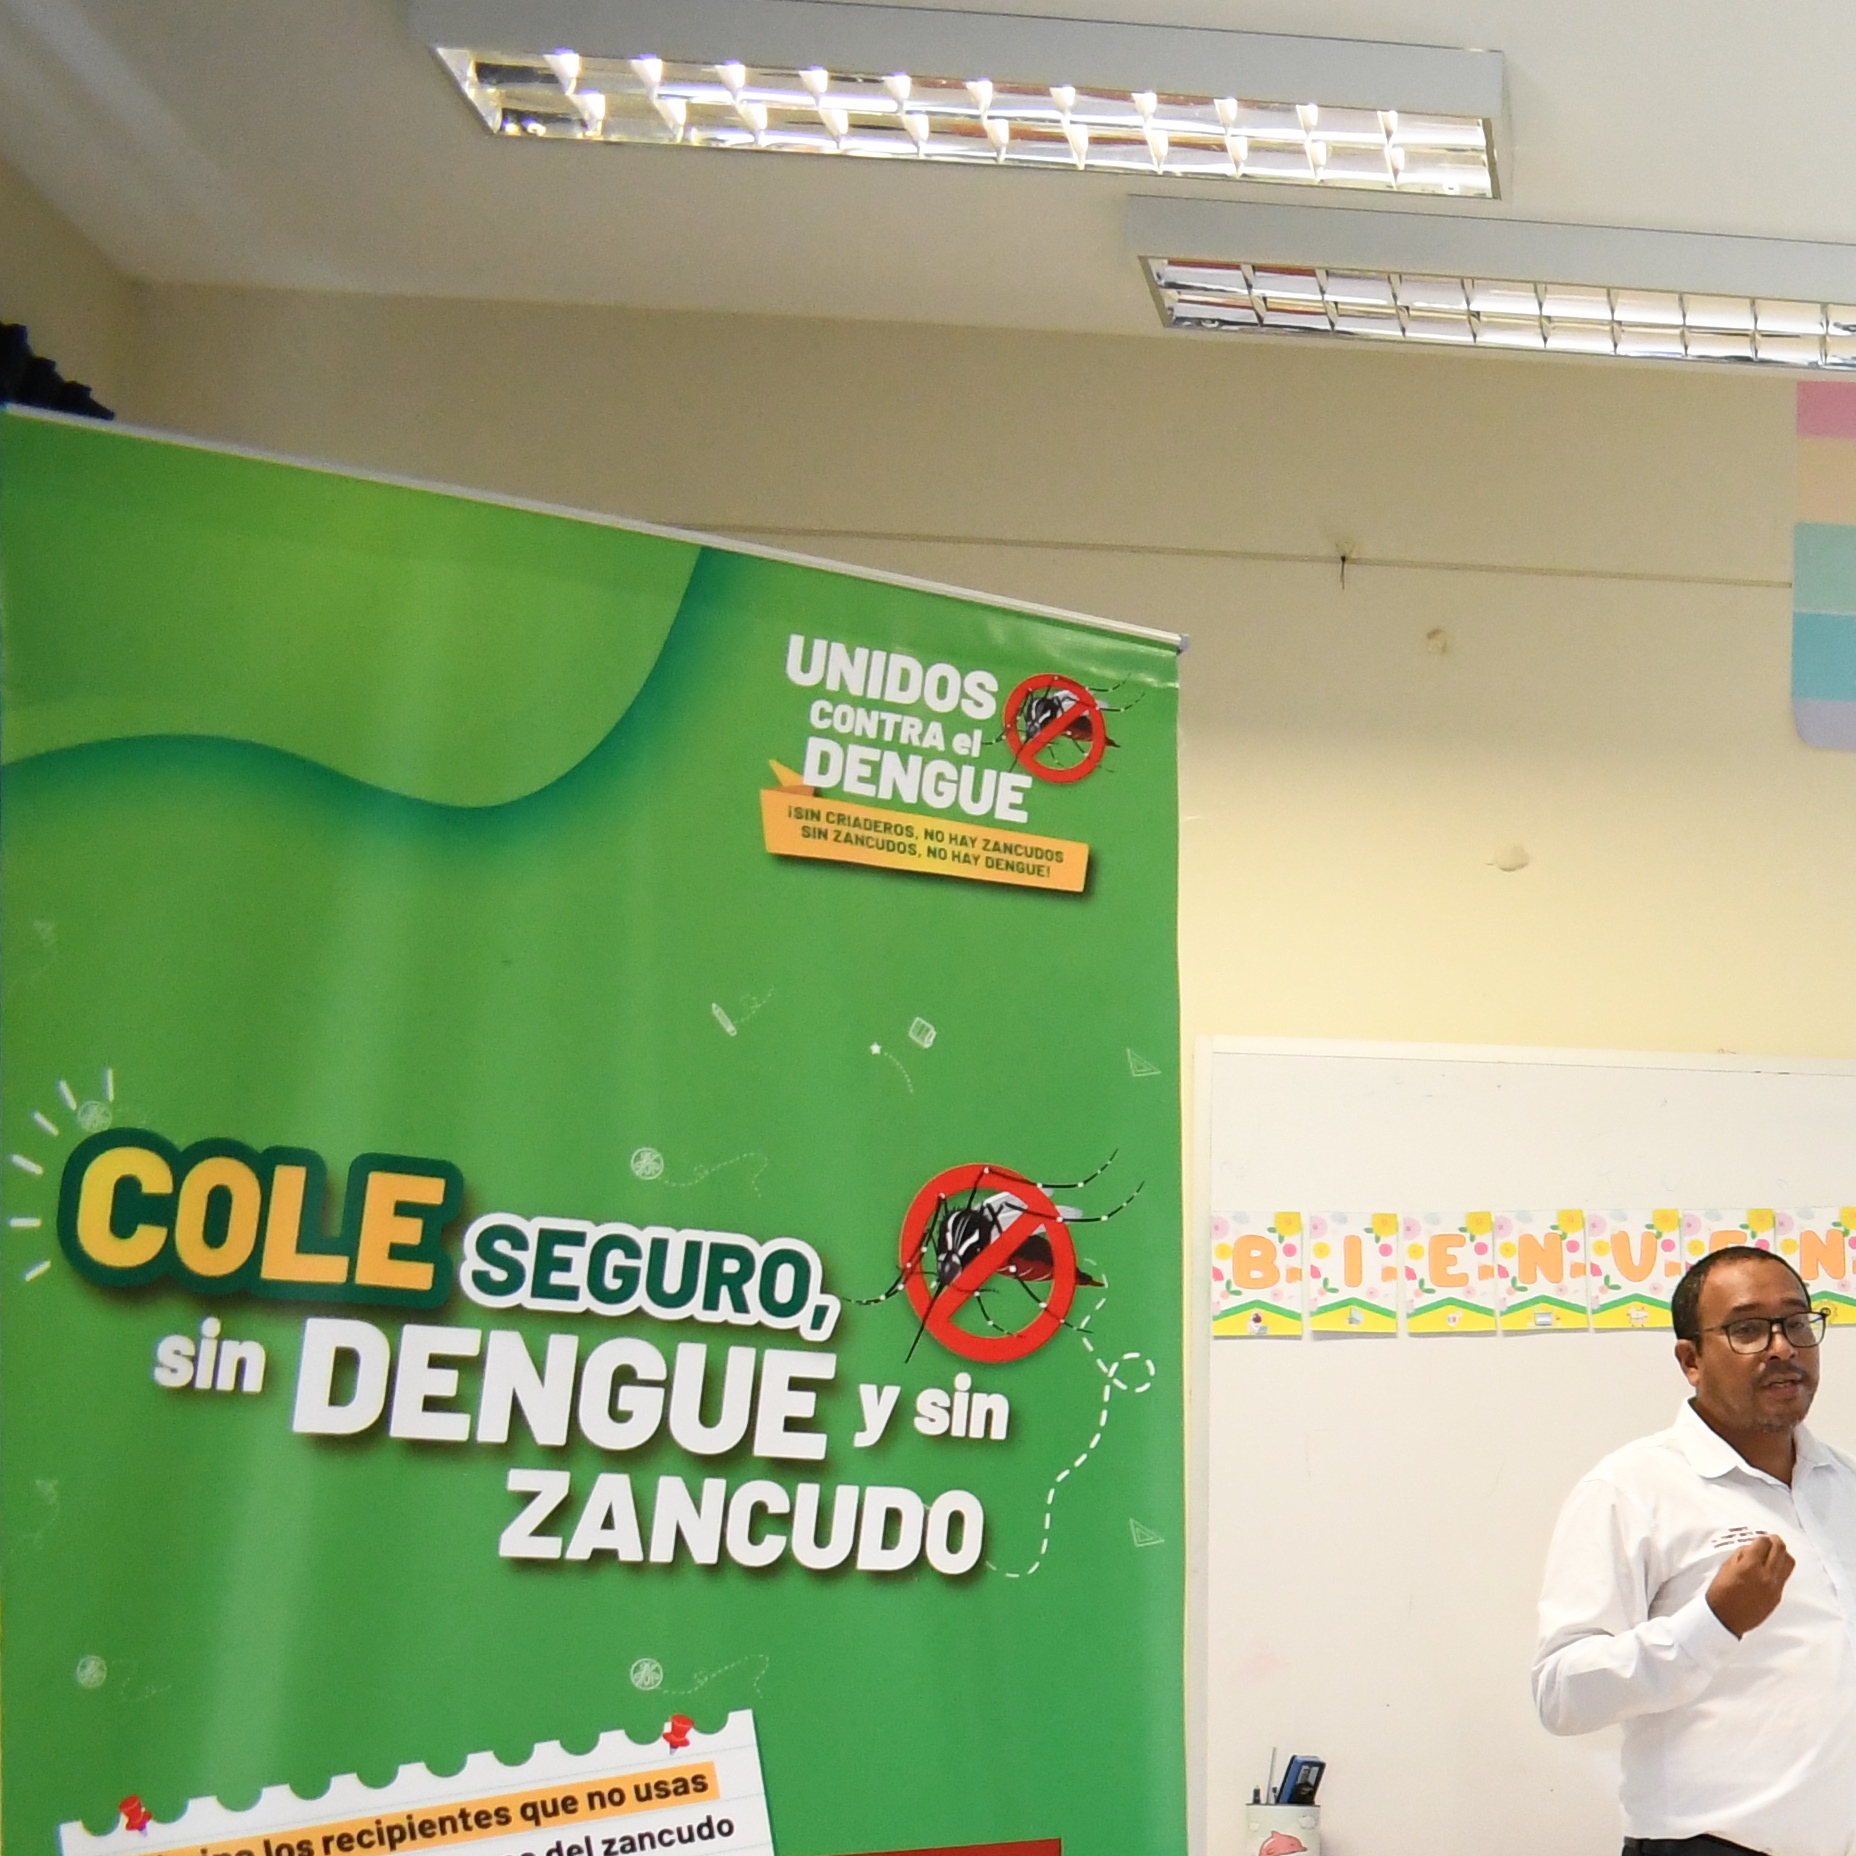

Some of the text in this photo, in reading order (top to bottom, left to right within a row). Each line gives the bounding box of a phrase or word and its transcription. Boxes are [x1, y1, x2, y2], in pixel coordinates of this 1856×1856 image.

[785, 633, 999, 720] UNIDOS
[810, 699, 982, 758] CONTRA el
[802, 736, 1033, 823] DENGUE
[787, 805, 1064, 864] ¡SIN CRIADEROS, NO HAY ZANCUDOS
[801, 825, 1051, 879] SIN ZANCUDOS, NO HAY DENGUE!
[74, 1144, 451, 1294] COLE
[468, 1226, 833, 1337] SEGURO,
[153, 1317, 1009, 1461] sin DENGUE y sin
[498, 1468, 985, 1577] ZANCUDO
[520, 1791, 579, 1829] que
[586, 1783, 626, 1812] no
[633, 1769, 709, 1805] usas
